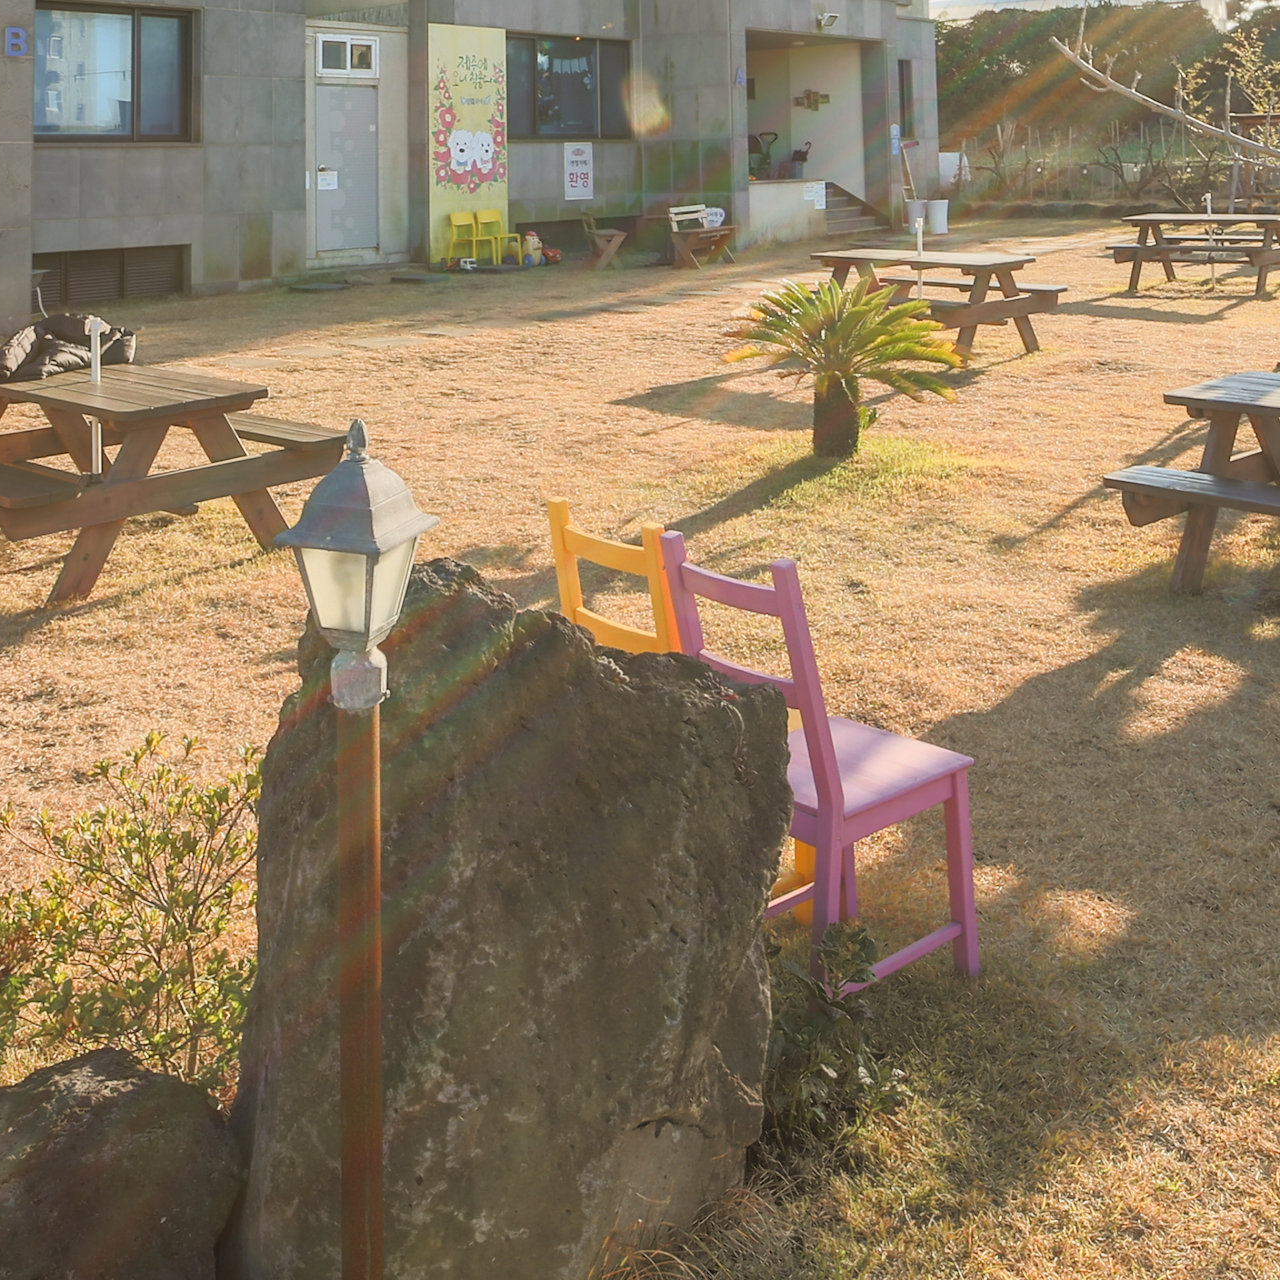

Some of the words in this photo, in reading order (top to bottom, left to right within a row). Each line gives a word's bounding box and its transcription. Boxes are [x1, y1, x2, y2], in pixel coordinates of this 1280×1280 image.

[5, 26, 28, 57] B
[735, 67, 746, 86] A
[568, 171, 589, 188] 환영
